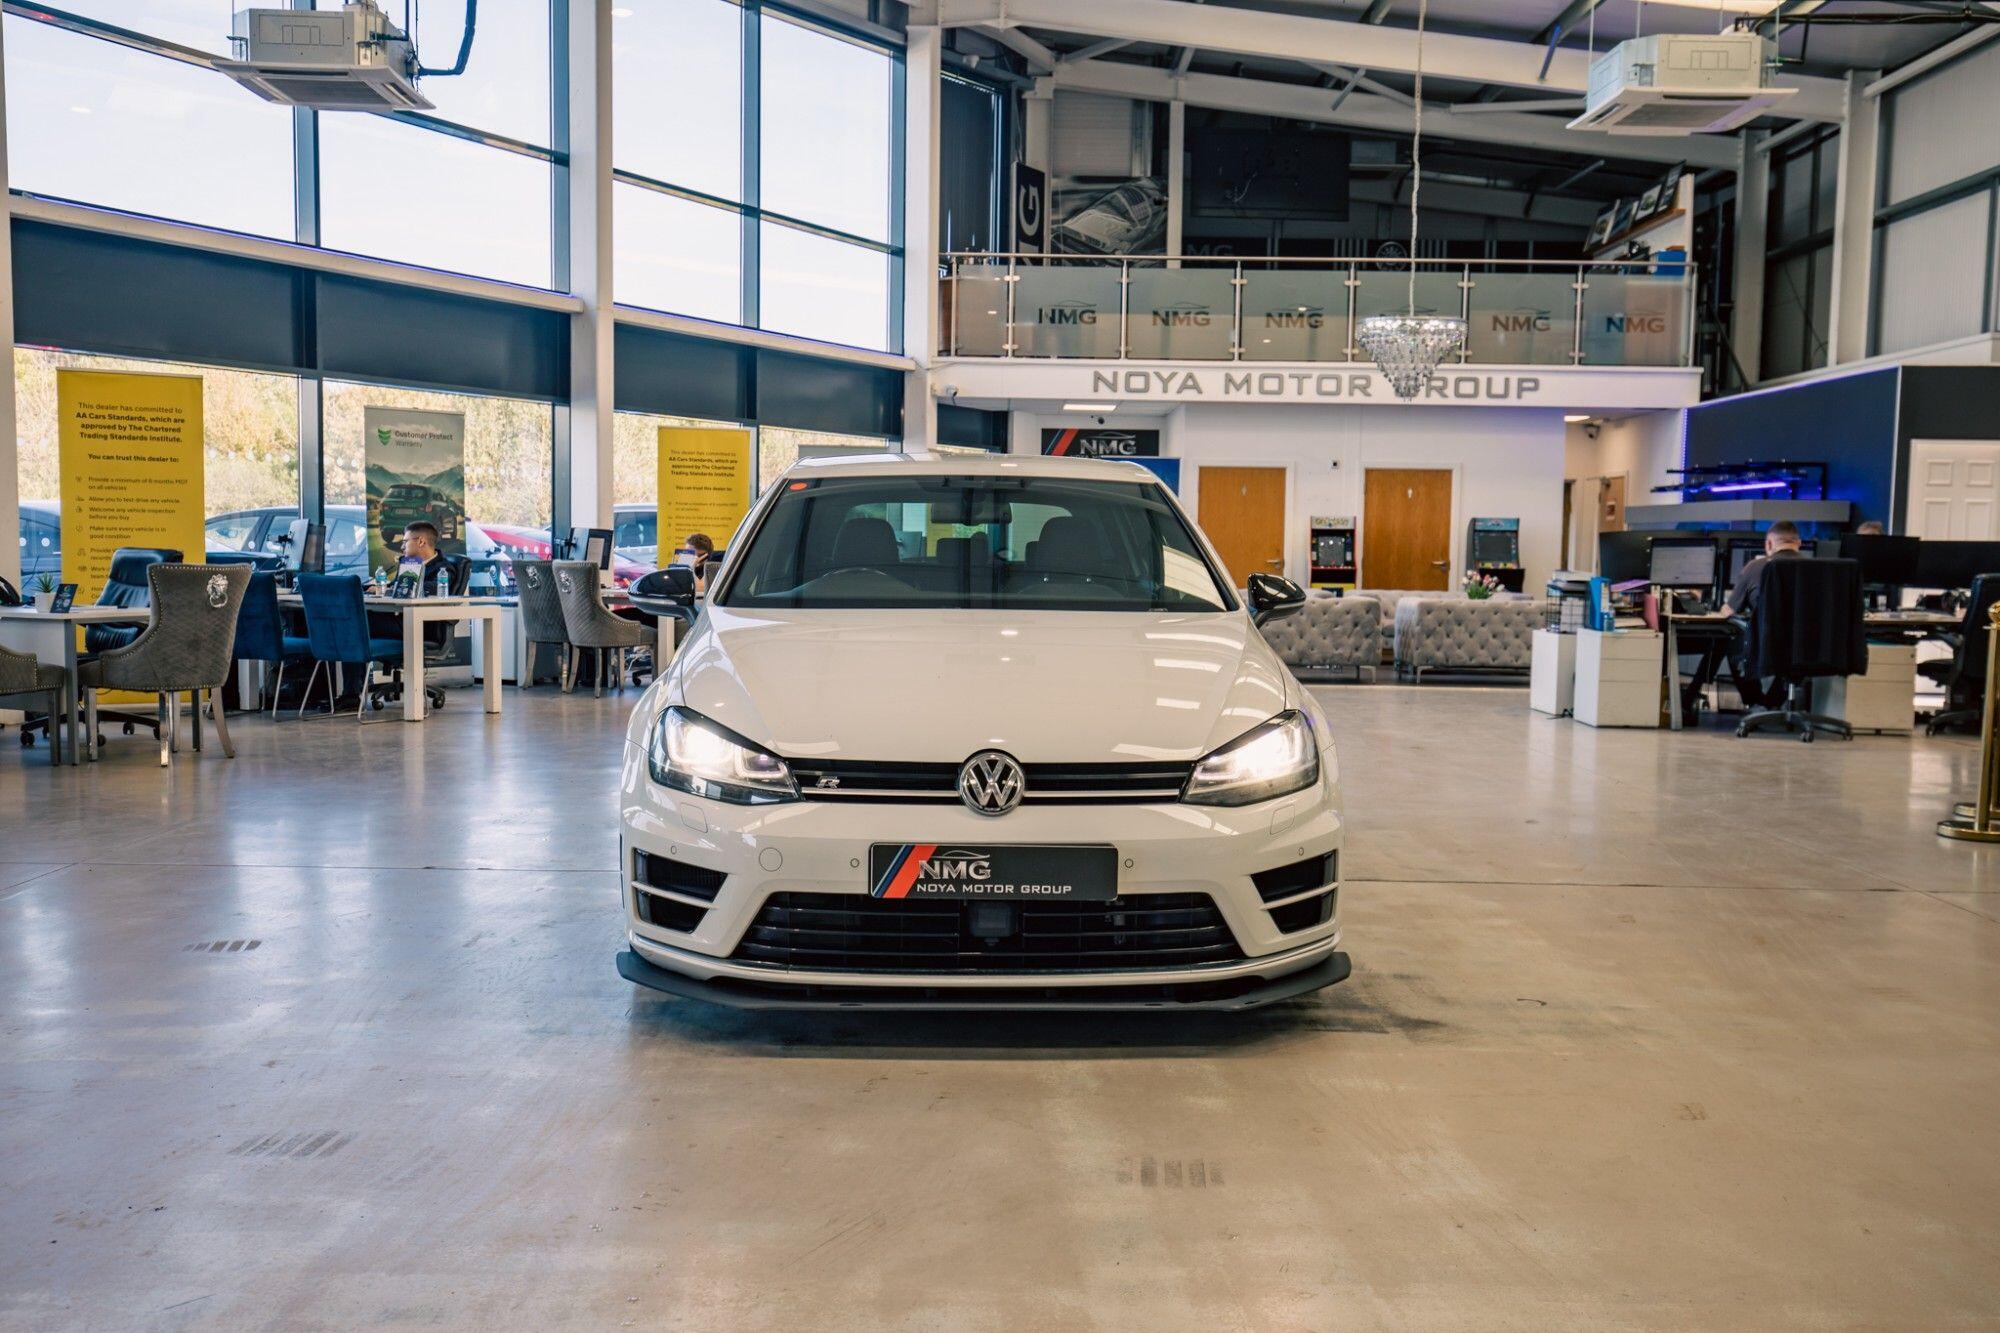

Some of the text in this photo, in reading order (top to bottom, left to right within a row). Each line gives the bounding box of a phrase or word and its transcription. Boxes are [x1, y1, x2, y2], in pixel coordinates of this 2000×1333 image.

[1038, 307, 1097, 325] NMG
[1152, 310, 1211, 327] NMG
[1265, 312, 1324, 329] NMG
[1492, 315, 1551, 332] NMG
[1605, 317, 1665, 334] NMG
[1093, 370, 1540, 399] NOYA MOTOR ROUP
[108, 414, 148, 422] Standards,
[80, 432, 108, 440] Trading
[110, 433, 148, 441] Standards
[395, 430, 427, 439] Customer
[1080, 438, 1137, 455] NMG
[963, 755, 1021, 811] VW
[918, 860, 992, 880] NMG
[916, 883, 1072, 894] NOYA MOTOR GROUP
